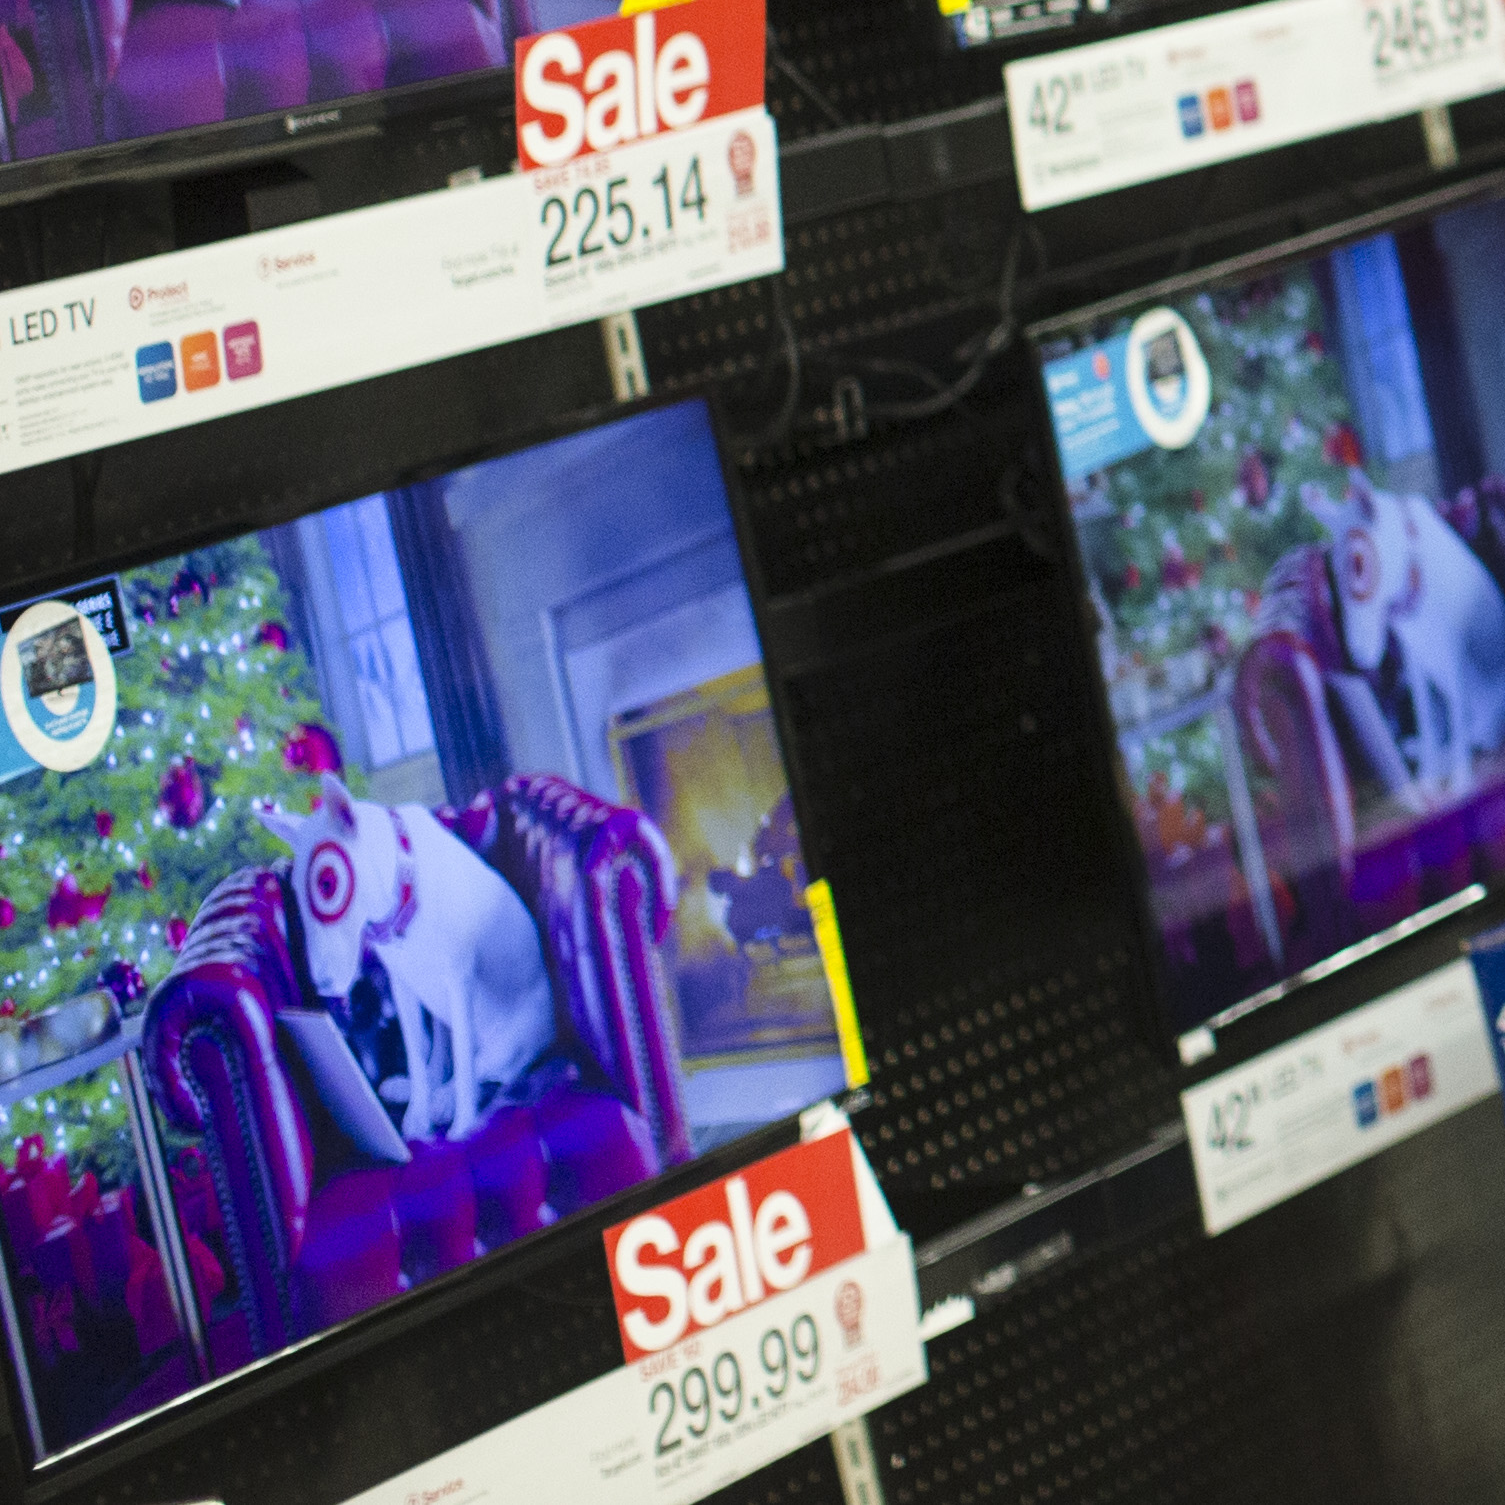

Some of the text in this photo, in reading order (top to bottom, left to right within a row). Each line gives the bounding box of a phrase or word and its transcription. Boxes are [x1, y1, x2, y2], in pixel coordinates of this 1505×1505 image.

[521, 11, 711, 167] Sale
[541, 154, 708, 269] 225.14
[10, 297, 96, 346] LED TV
[615, 1175, 814, 1352] Sale
[649, 1313, 820, 1459] 299.99
